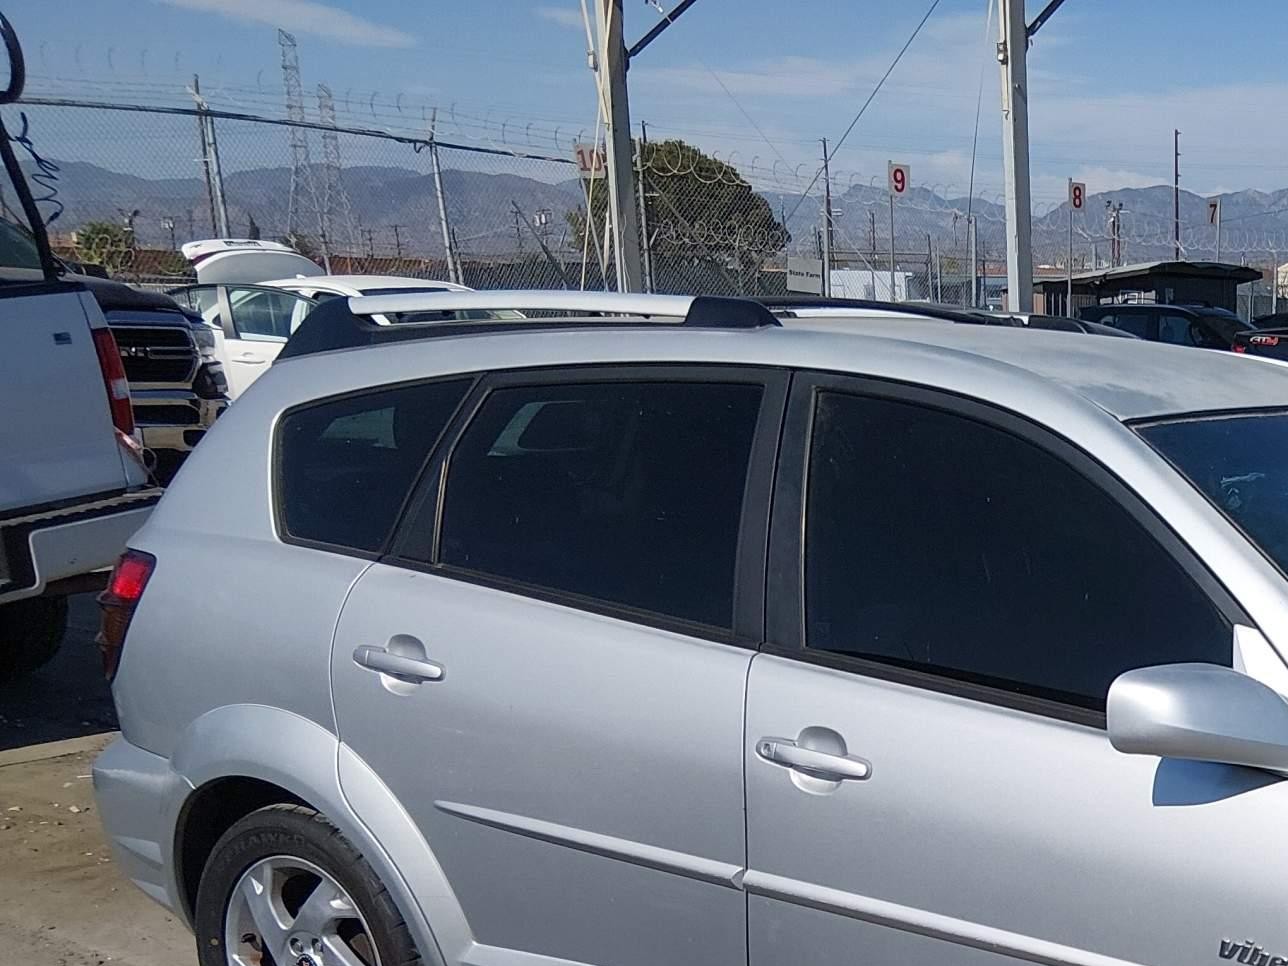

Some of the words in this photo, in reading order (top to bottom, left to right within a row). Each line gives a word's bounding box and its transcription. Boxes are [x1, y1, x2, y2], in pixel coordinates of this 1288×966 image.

[577, 149, 603, 171] 10
[893, 168, 905, 193] 9
[1073, 186, 1082, 208] 8
[1209, 203, 1218, 223] 7
